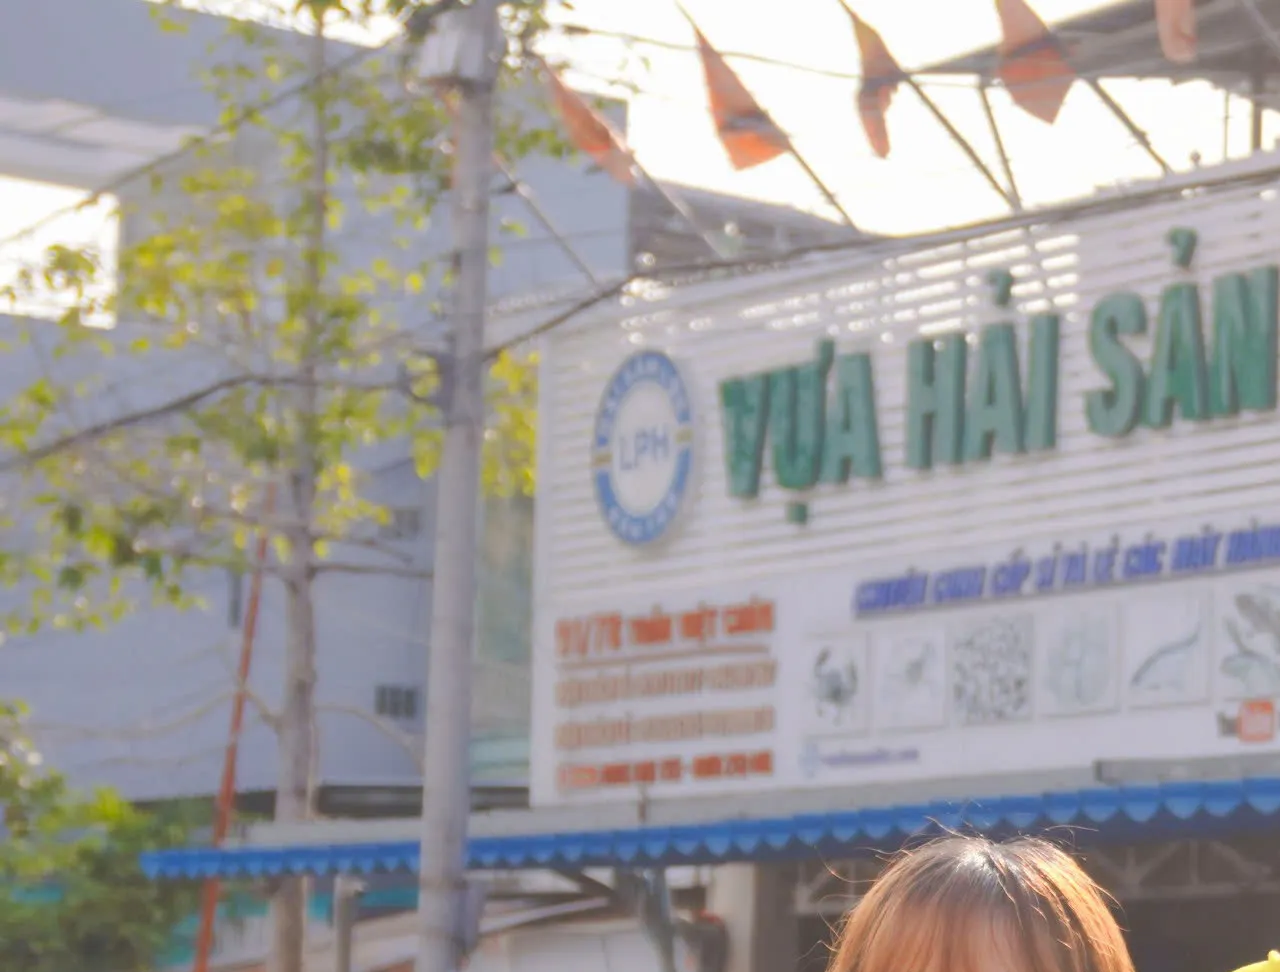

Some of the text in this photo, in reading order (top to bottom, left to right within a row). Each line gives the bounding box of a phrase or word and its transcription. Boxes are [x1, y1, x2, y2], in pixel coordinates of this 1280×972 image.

[620, 426, 670, 471] LPH
[719, 338, 882, 525] VỰA
[905, 270, 1060, 471] HẢI
[1083, 228, 1280, 438] SẢN
